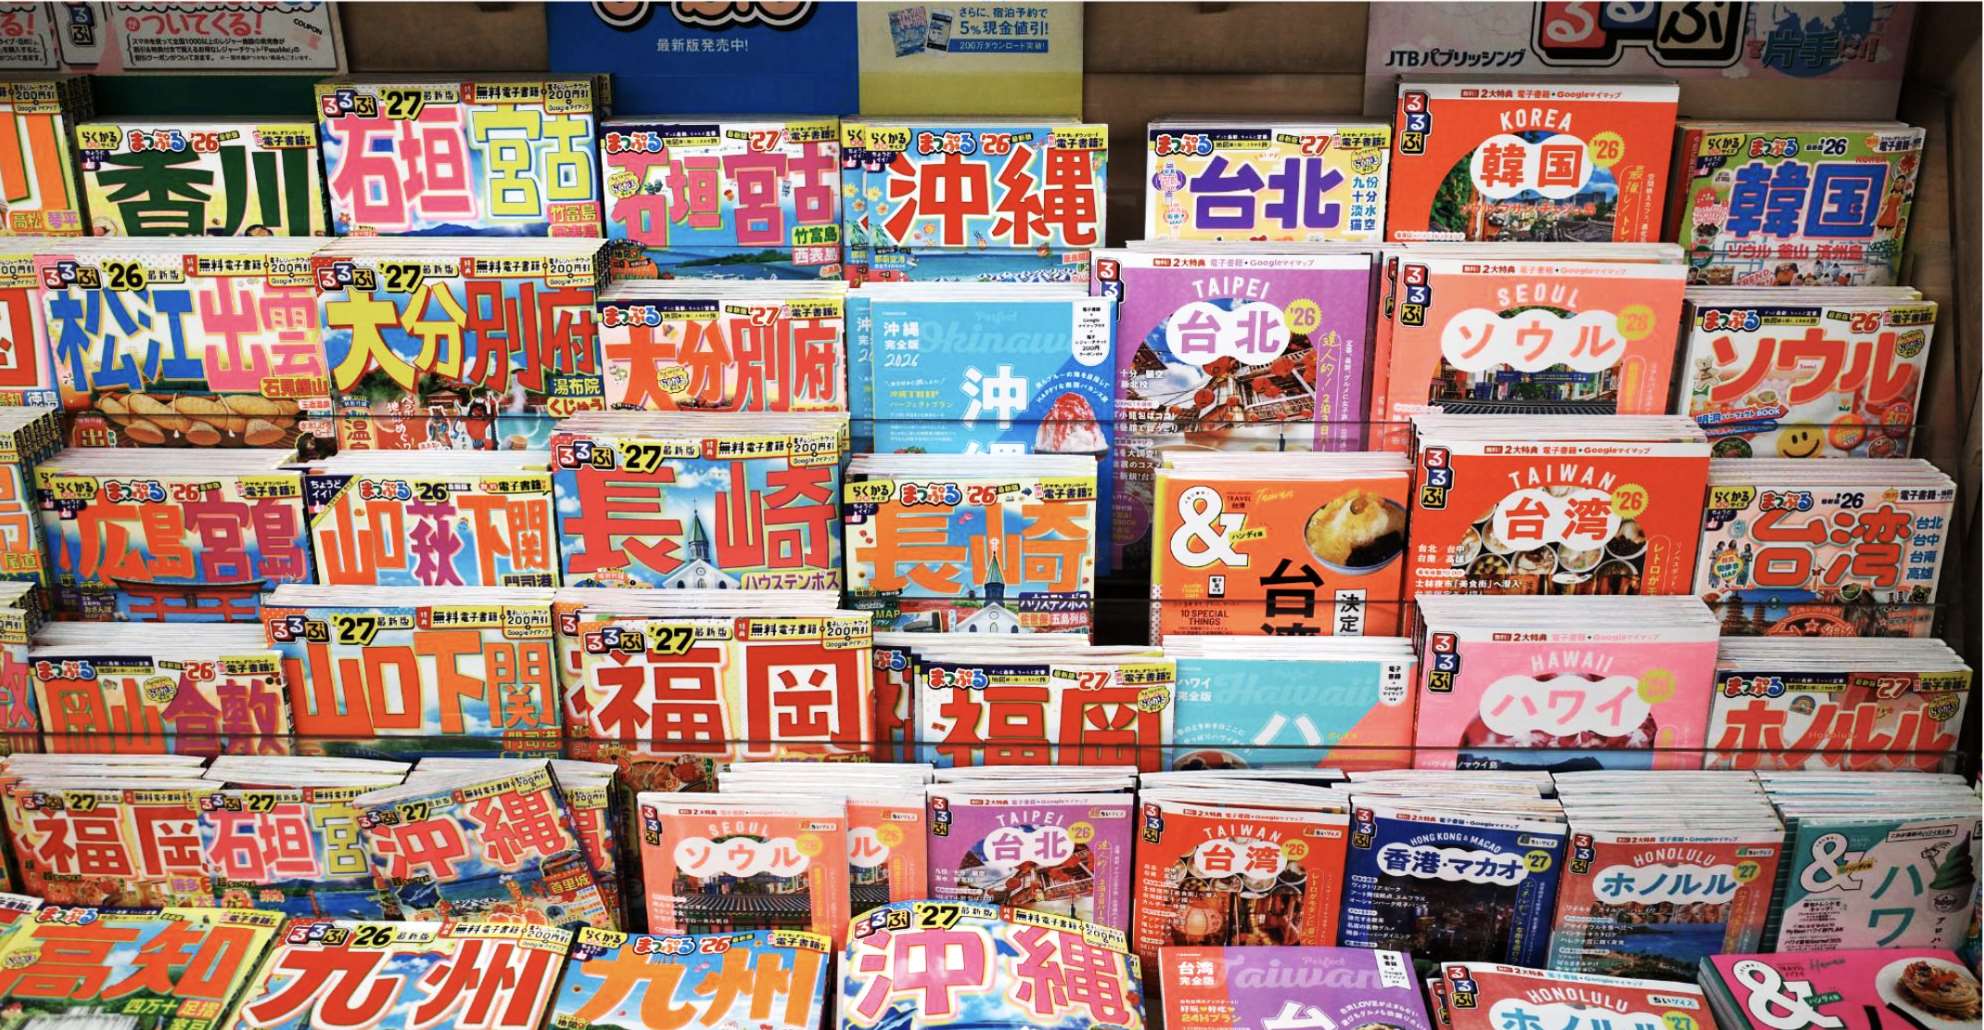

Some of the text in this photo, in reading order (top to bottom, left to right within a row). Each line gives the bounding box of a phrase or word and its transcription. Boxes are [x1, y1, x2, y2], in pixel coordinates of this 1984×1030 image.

[960, 8, 1048, 18] さらに、宿泊予約で
[293, 18, 323, 34] COUPON
[960, 22, 1049, 36] 5%現金値引!
[657, 39, 749, 52] 最新版発売中!
[960, 40, 1046, 50] 200万ダウンロード突破!
[1385, 49, 1526, 67] JTBパブリッシング
[476, 85, 539, 99] 無料電子書籍
[549, 90, 589, 100] 200円引
[1480, 89, 1513, 98] 2大特典
[321, 91, 376, 116] るるぶ
[1403, 92, 1431, 151] るるぶ
[1500, 108, 1573, 131] KOREA
[127, 129, 186, 152] まっぷる
[605, 131, 663, 152] まっぷる
[918, 132, 975, 154] まっぷる
[1156, 134, 1213, 156] まっぷる
[1480, 143, 1583, 188] 韓国
[96, 146, 321, 237] 香川
[1190, 156, 1344, 229] 台北
[1352, 177, 1378, 189] 九份
[885, 145, 1097, 246] 沖縄
[1352, 191, 1378, 202] 十分
[1727, 161, 1889, 238] 韓国
[551, 206, 597, 223] 竹富島
[794, 226, 838, 242] 竹富島
[1728, 244, 1771, 259] ソウル
[1777, 244, 1809, 259] 釜山
[199, 259, 262, 272] 無料電子書籍
[271, 264, 312, 273] 200円引
[476, 260, 541, 273] 無料電子書籍
[550, 264, 591, 274] 200円引
[1173, 258, 1206, 267] 2大特典
[1483, 266, 1515, 274] 2大特典
[44, 262, 144, 289] るるぶ '26
[320, 263, 421, 290] るるぶ '27
[1192, 277, 1270, 299] TAIPEI
[1497, 284, 1580, 307] SEOUL
[602, 305, 661, 326] まっぷる
[1703, 310, 1761, 331] まっぷる
[327, 280, 595, 393] 大分別府
[883, 321, 919, 337] 沖縄
[1178, 309, 1283, 354] 台北
[884, 340, 919, 350] 完全版
[1460, 320, 1615, 362] ソウル
[606, 319, 839, 412] 大分別府
[884, 353, 918, 367] 2026
[1712, 328, 1913, 406] ソウル
[263, 379, 328, 397] 石見銀山
[554, 378, 601, 394] 湯布院
[558, 443, 662, 471] るるぶ '27
[718, 441, 784, 455] 無料電子書籍
[794, 441, 835, 453] 200円引
[1504, 445, 1539, 454] 2大特典
[311, 479, 341, 489] ちょうど
[1422, 447, 1451, 509] るるぶ
[1508, 464, 1617, 490] TAIWAN
[104, 480, 165, 501] まっぷる
[360, 480, 410, 500] まっぷる
[901, 483, 961, 505] まっぷる
[563, 461, 837, 574] 長崎
[1506, 497, 1612, 541] 台湾
[1916, 516, 1942, 529] 台北
[59, 489, 304, 585] 広島宮島
[855, 500, 1089, 593] 長崎
[1752, 505, 1912, 587] 台湾
[1912, 534, 1939, 546] 台中
[1418, 544, 1437, 553] 台北
[1909, 550, 1936, 564] 台南
[745, 572, 839, 589] ハウステンボス
[1906, 567, 1933, 580] 高雄
[433, 611, 498, 624] 無料電子書籍
[507, 615, 548, 625] 200円引
[1181, 609, 1228, 618] 10 SPECIAL
[1189, 618, 1221, 626] THINGS
[271, 616, 375, 644] るるぶ '27
[585, 627, 693, 653] るるぶ '27
[751, 623, 817, 636] 無料電子書籍
[827, 626, 868, 637] 200円引
[1513, 633, 1547, 642] 2大特典
[36, 661, 97, 680] まっぷる
[1429, 634, 1459, 691] るるぶ
[1530, 650, 1615, 673] HAWAII
[282, 631, 556, 736] 山口下関
[928, 668, 990, 690] まっぷる
[1178, 677, 1210, 689] ハワイ
[597, 644, 861, 754] 福岡
[1491, 686, 1635, 725] ハワイ
[937, 687, 1162, 771] 福岡
[1715, 701, 1957, 770] ホノルル
[708, 821, 769, 836] SEOUL
[996, 812, 1064, 826] TAIPEI
[33, 806, 201, 876] 福岡
[208, 806, 317, 880] 石垣
[371, 791, 567, 880] 沖縄
[1203, 824, 1282, 843] TAIWAN
[1410, 835, 1436, 846] HONG
[1437, 833, 1462, 842] KONG
[1470, 835, 1502, 854] MACAO
[992, 831, 1067, 860] 台北
[685, 845, 800, 870] ソウル
[1203, 843, 1280, 874] 台湾
[1384, 847, 1523, 880] 香港・マカオ
[1634, 847, 1716, 867] HONOLULU
[1602, 873, 1737, 897] ホノルル
[455, 924, 520, 935] 無料電子書籍
[1015, 909, 1077, 931] 無料電子書籍
[288, 924, 349, 945] るるぶ
[634, 936, 696, 955] まっぷる
[1, 919, 256, 1000] 高知
[1176, 961, 1214, 976] 台湾
[859, 928, 1130, 1025] 沖縄
[1178, 976, 1215, 986] 完全版
[1203, 955, 1383, 989] Taiwan
[249, 940, 545, 1027] 九州
[574, 944, 819, 1029] 九州
[124, 1001, 177, 1015] 四万十
[1526, 987, 1629, 1012] HONOLULU
